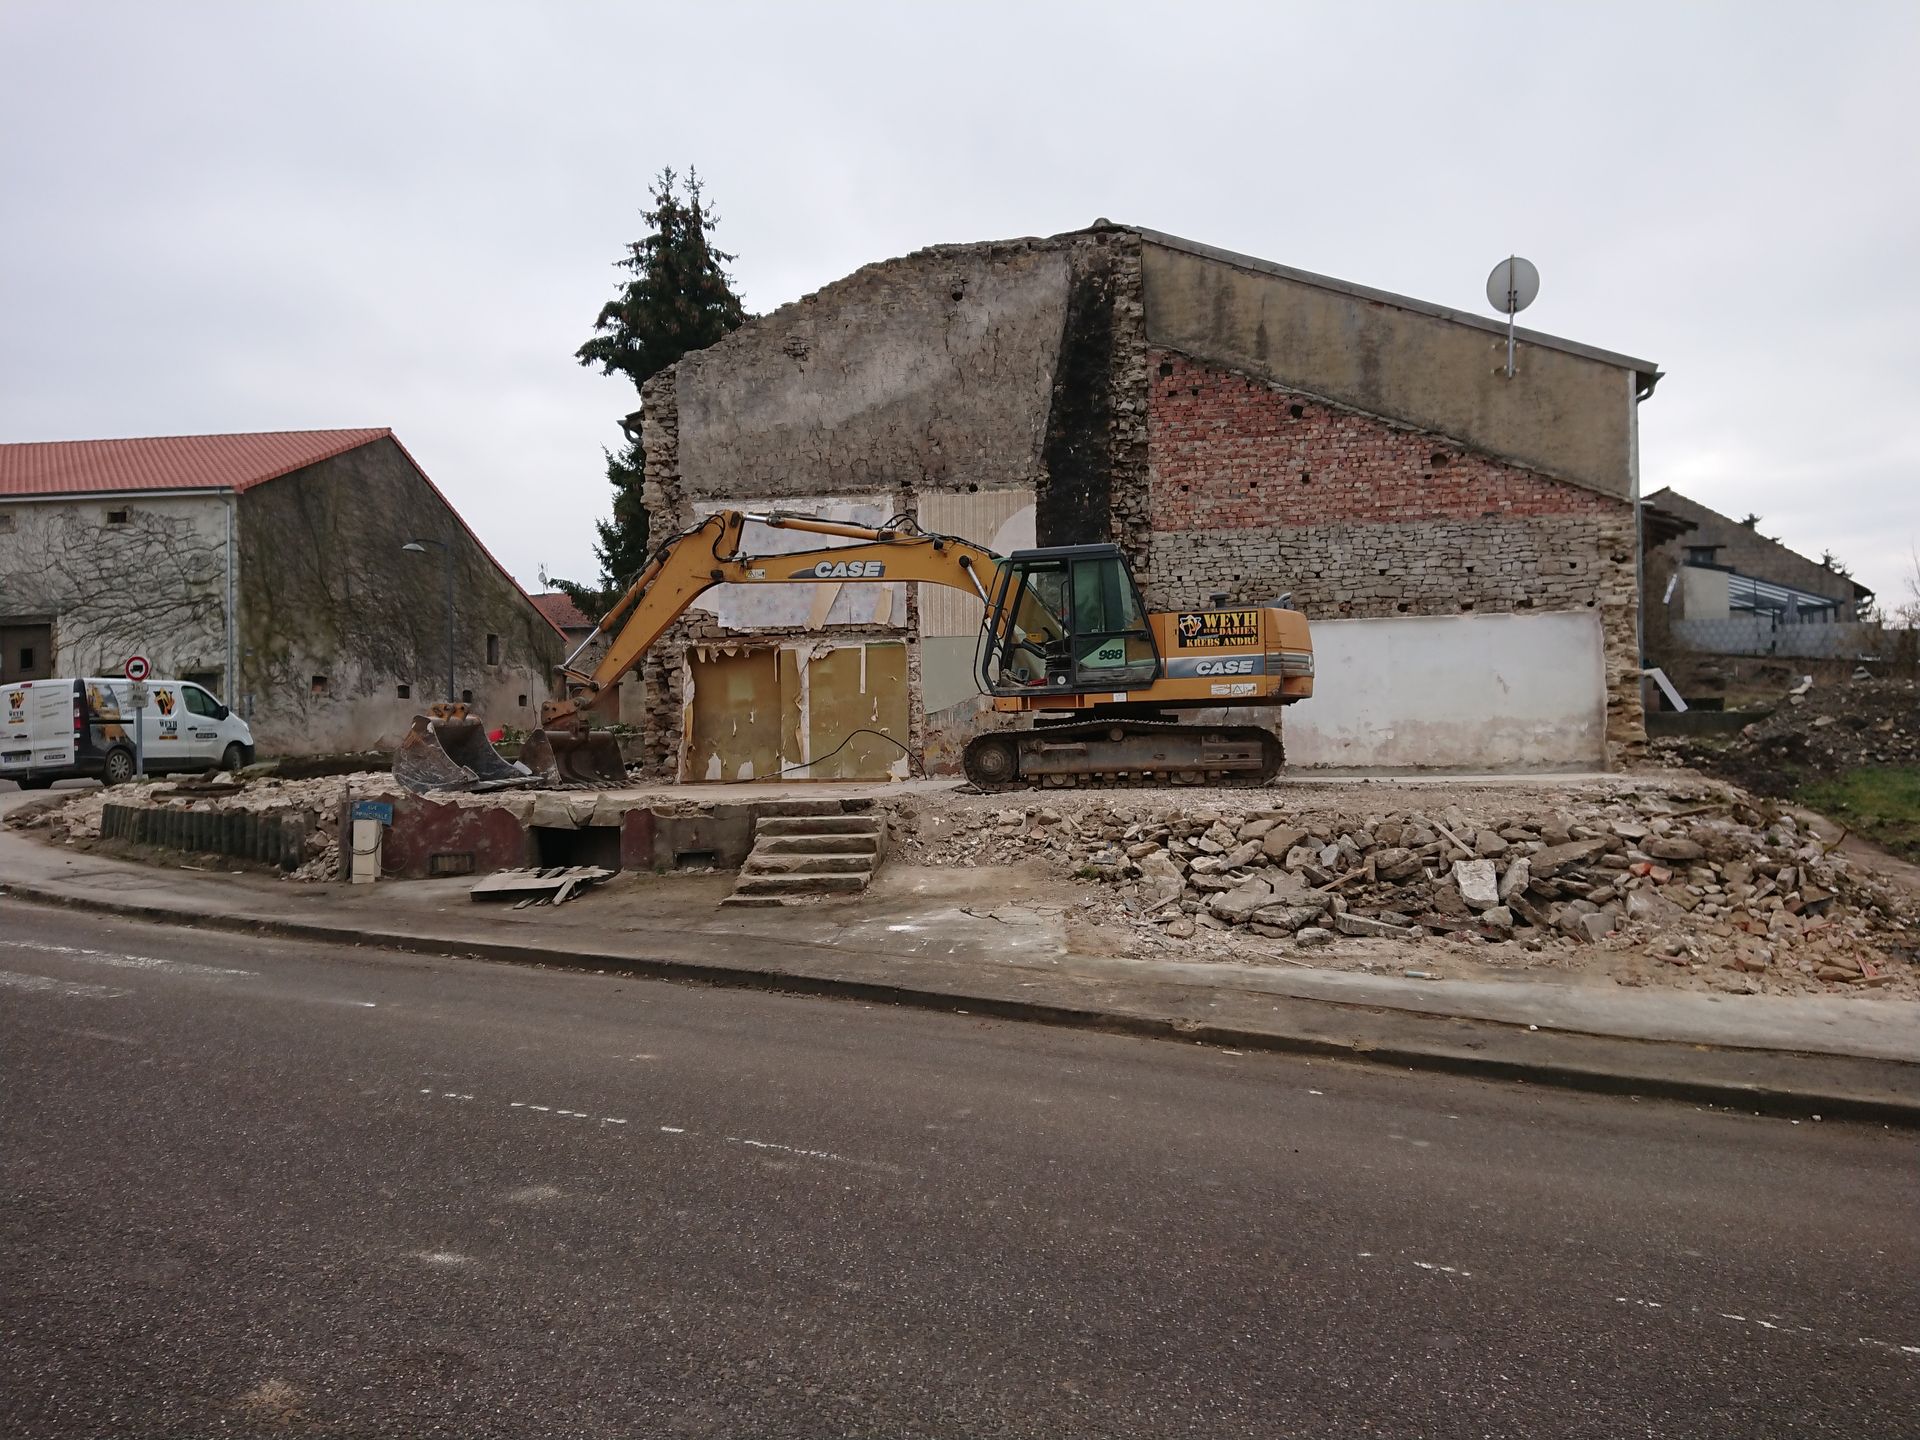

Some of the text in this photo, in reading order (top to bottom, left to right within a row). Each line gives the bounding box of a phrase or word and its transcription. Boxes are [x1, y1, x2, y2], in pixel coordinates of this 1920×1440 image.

[814, 560, 882, 578] CASE
[1203, 612, 1257, 628] WEYH
[1219, 626, 1257, 635] DAMIEN
[1186, 638, 1220, 647] KREBS
[1223, 635, 1257, 646] ANDRÉ
[1099, 649, 1123, 661] 988
[1195, 660, 1254, 675] CASE
